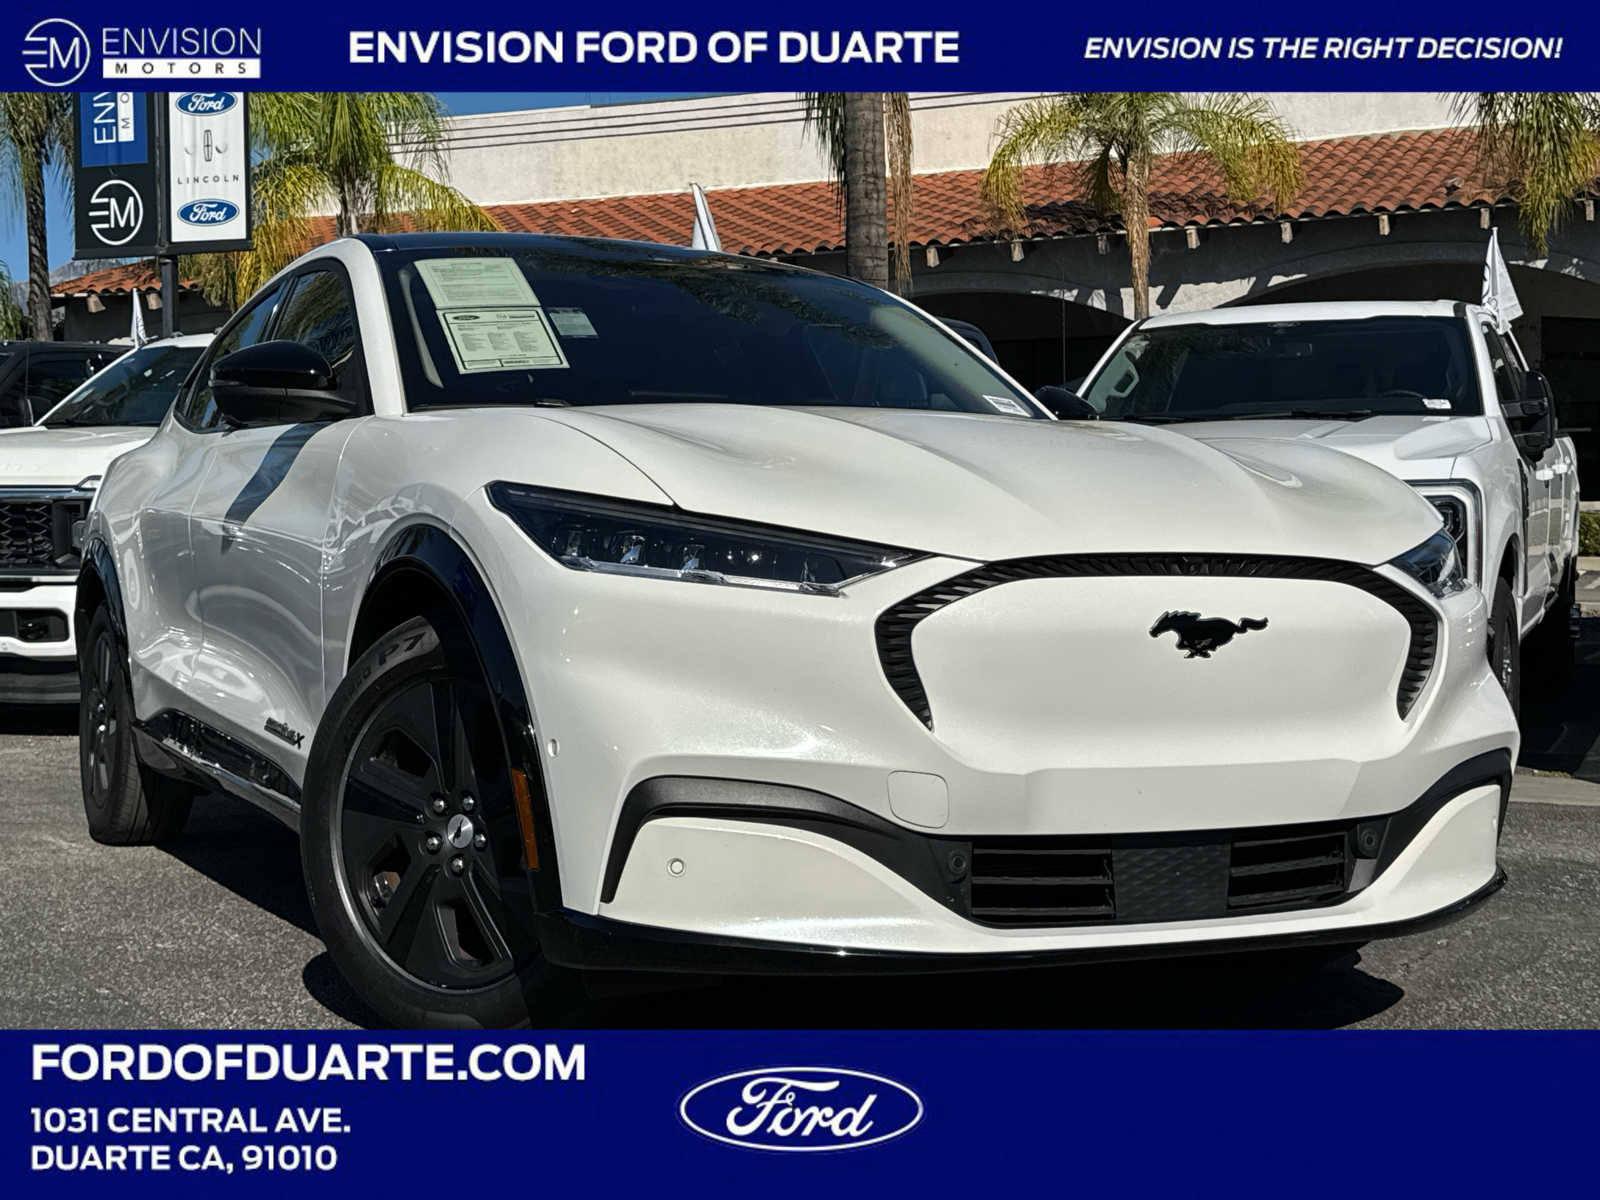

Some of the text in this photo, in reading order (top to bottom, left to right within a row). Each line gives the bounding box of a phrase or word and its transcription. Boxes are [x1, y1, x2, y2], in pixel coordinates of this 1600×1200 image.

[187, 92, 225, 111] Ford
[177, 174, 240, 185] LINCOLN
[189, 203, 227, 222] Ford
